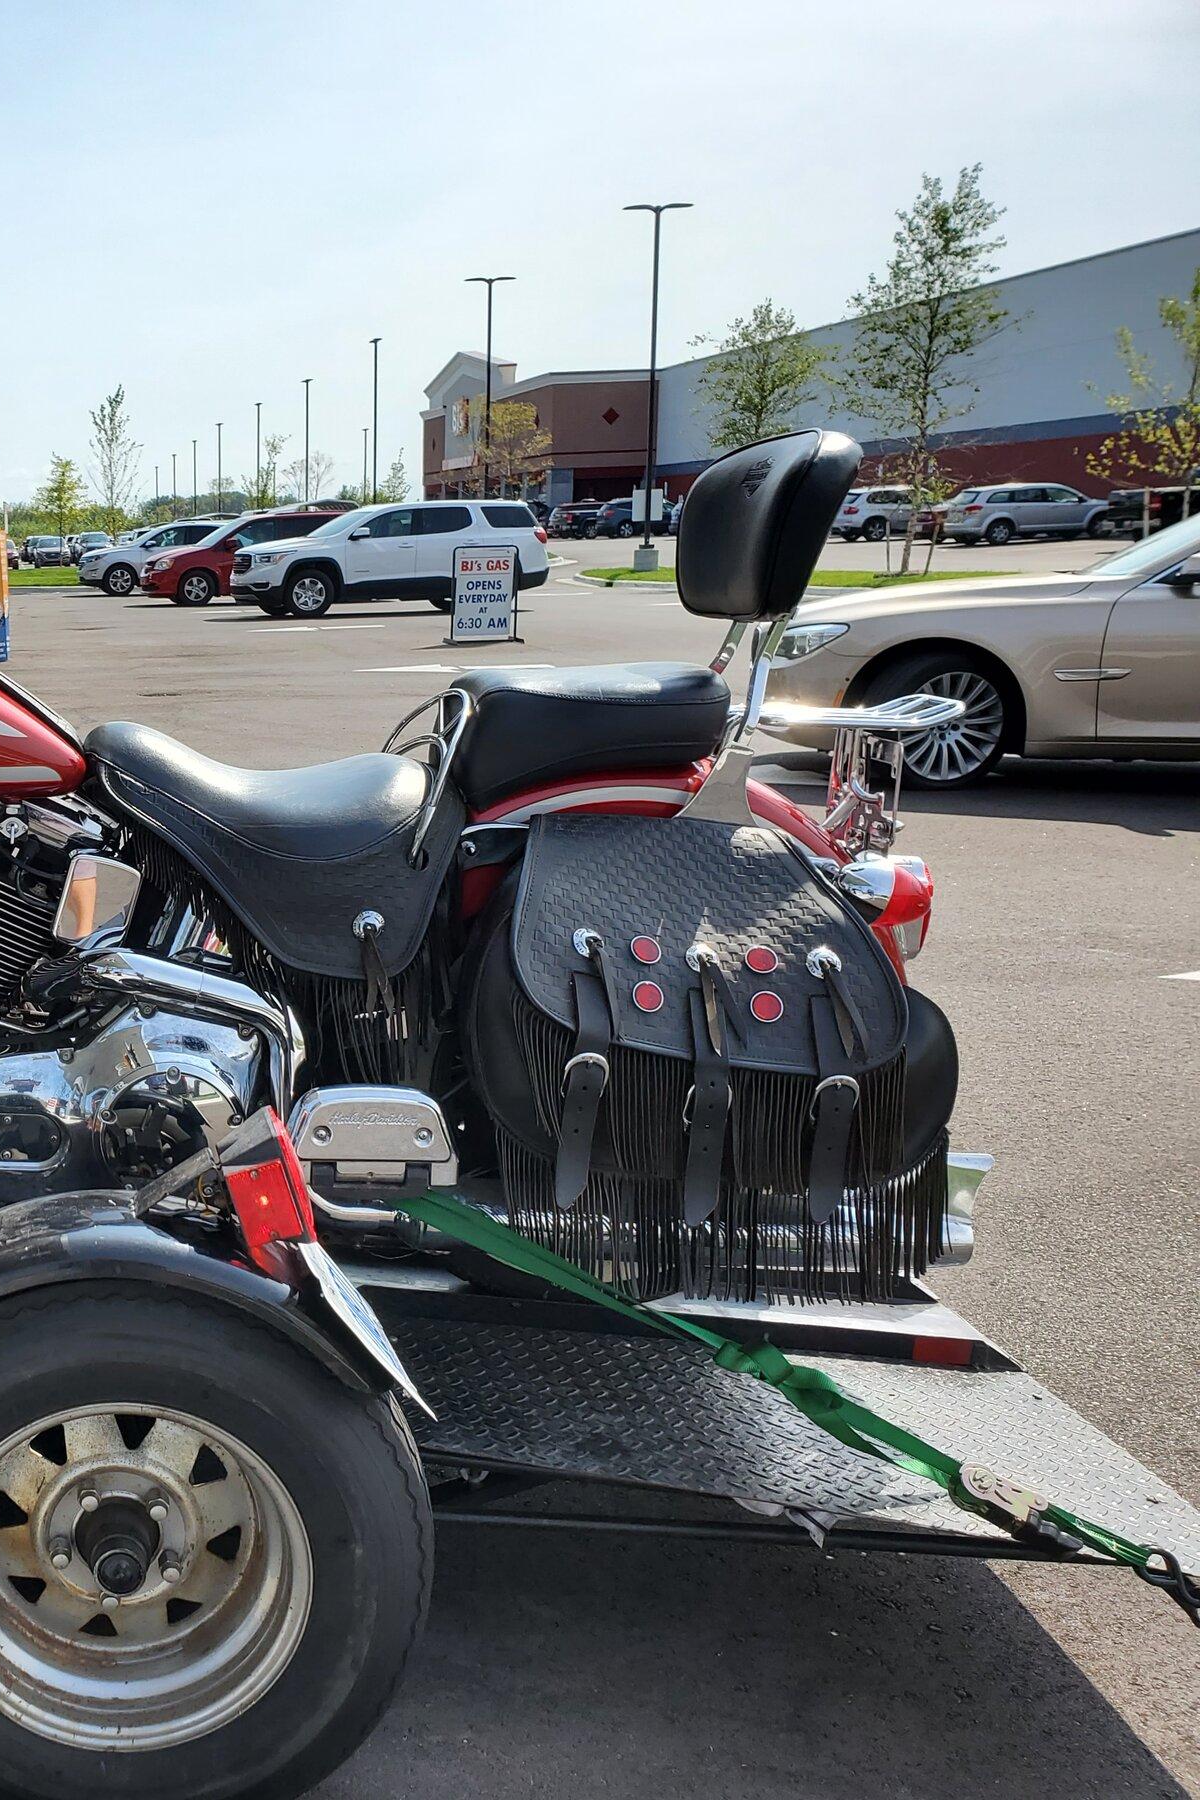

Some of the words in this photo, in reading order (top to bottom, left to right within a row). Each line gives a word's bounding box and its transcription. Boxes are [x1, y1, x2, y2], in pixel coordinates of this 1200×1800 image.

[461, 561, 482, 572] BJ's
[486, 559, 510, 571] GAS
[466, 580, 502, 590] OPENS
[458, 593, 508, 603] EVERYDAY
[457, 617, 482, 629] 6:30
[487, 617, 508, 628] AM
